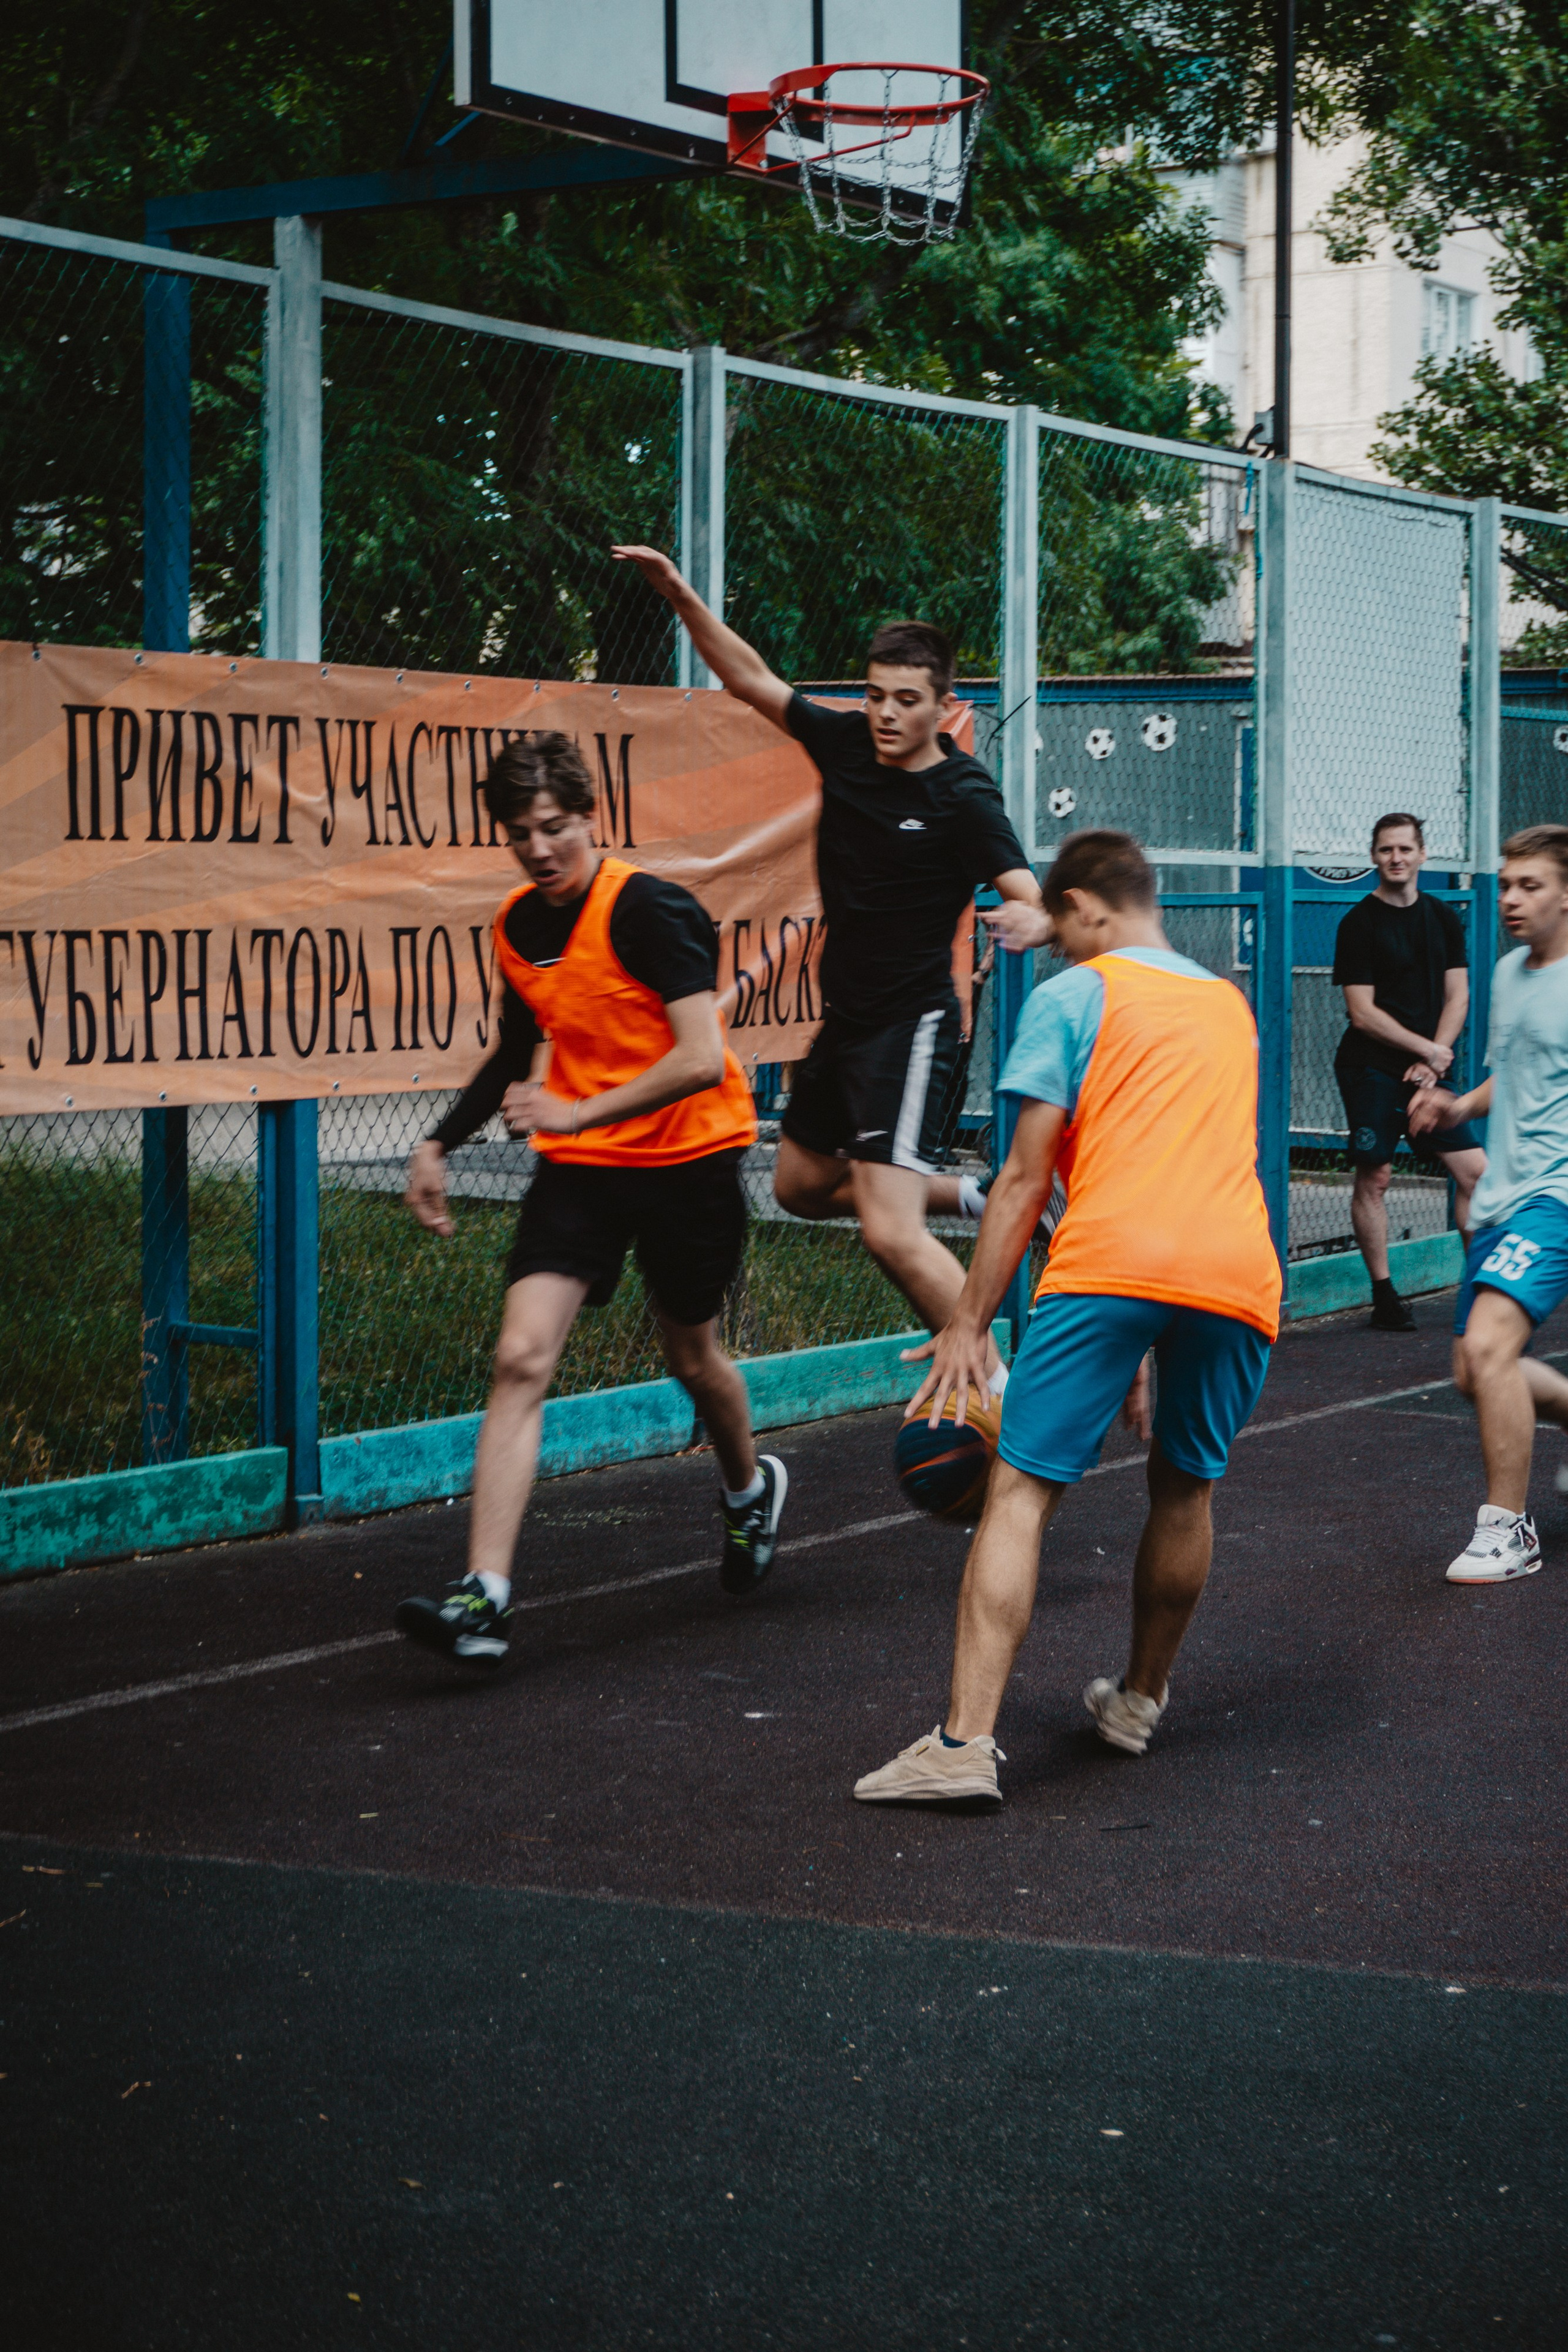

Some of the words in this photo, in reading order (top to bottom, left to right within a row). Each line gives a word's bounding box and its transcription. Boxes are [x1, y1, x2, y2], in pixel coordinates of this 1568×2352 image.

[62, 704, 300, 845] ПРИВЕТ
[315, 717, 636, 849] УЧАСТНМ
[389, 925, 456, 1051] ПО
[1481, 1233, 1541, 1281] 55
